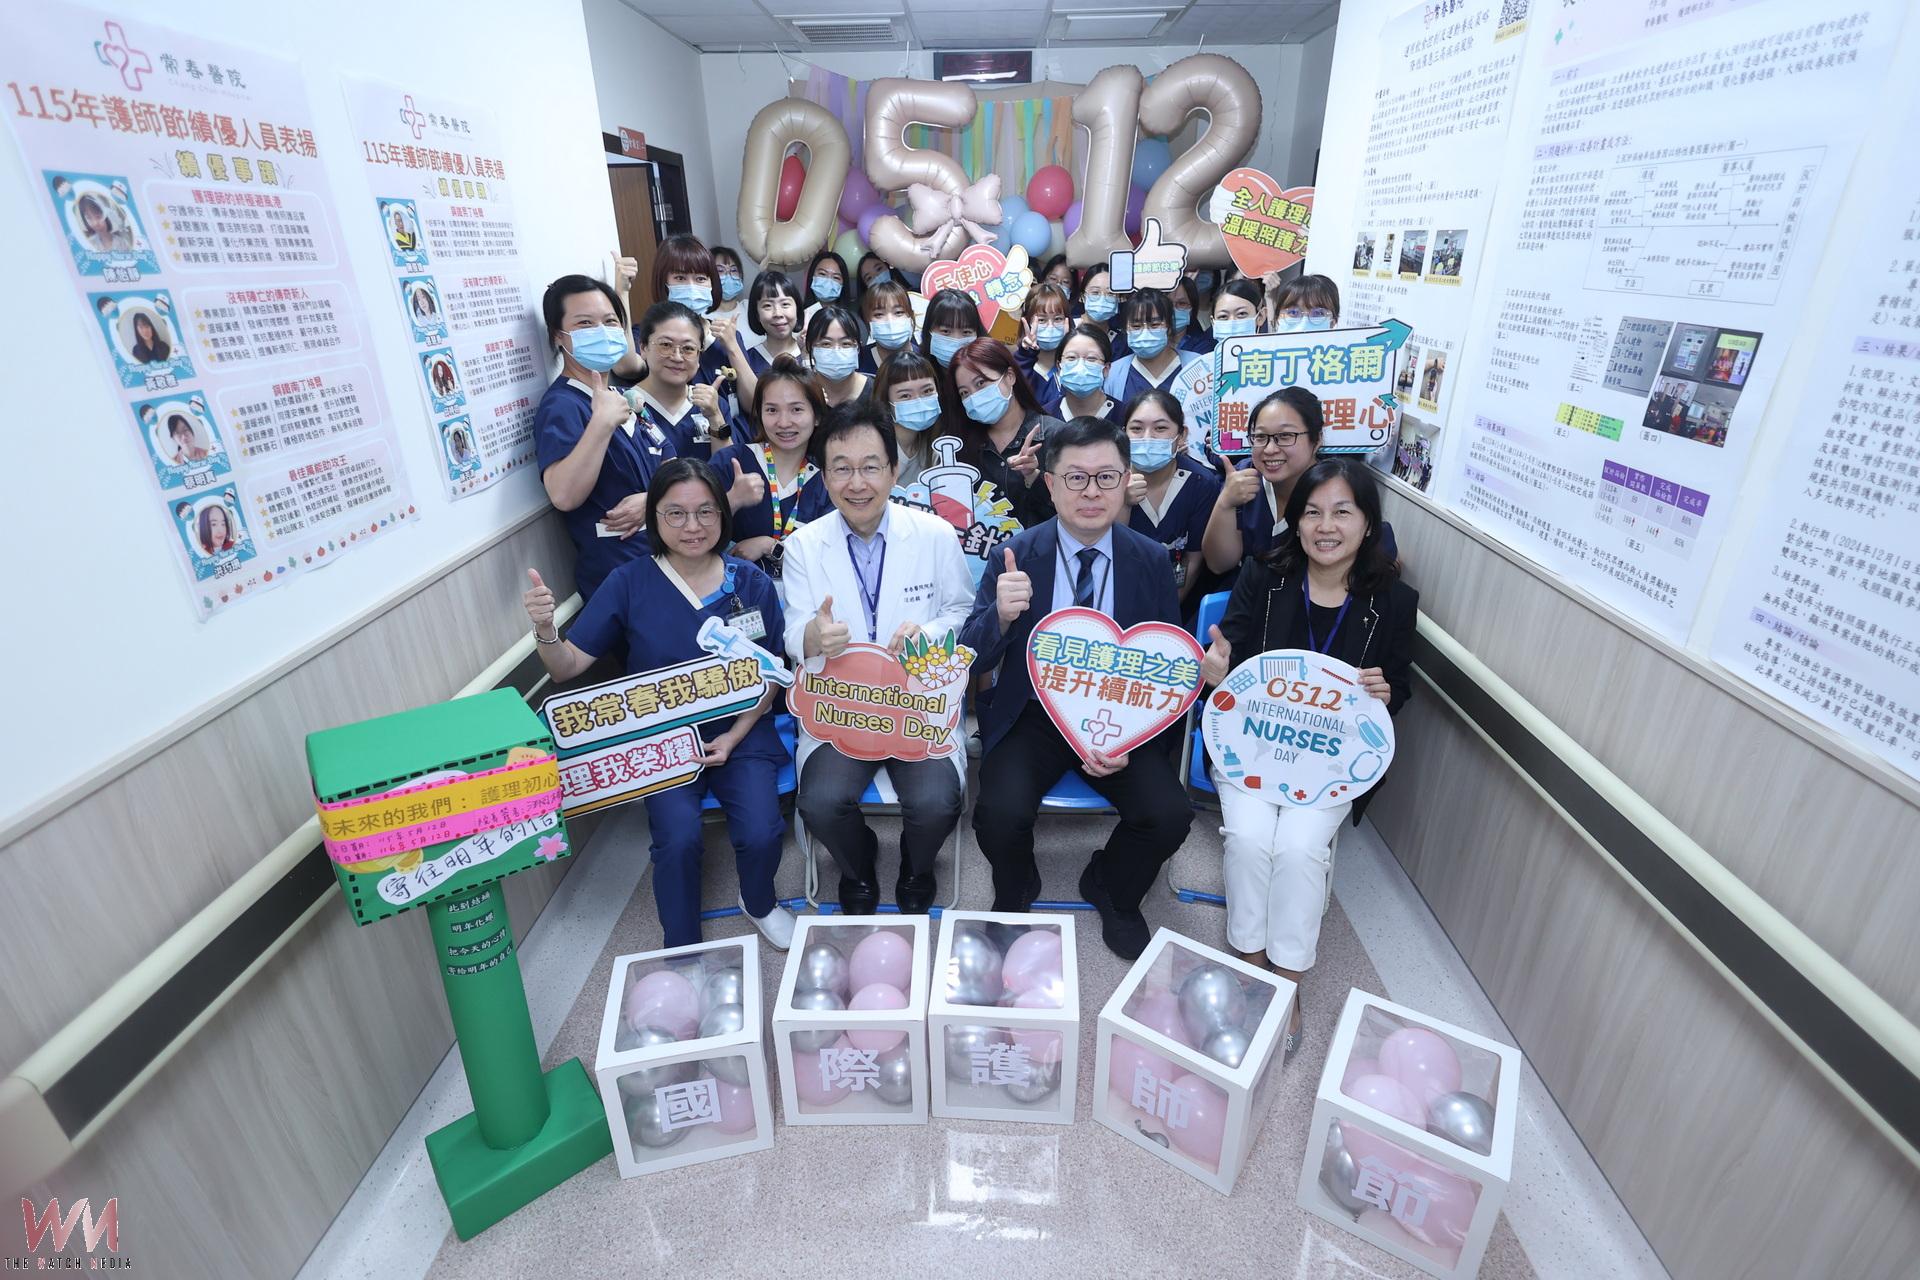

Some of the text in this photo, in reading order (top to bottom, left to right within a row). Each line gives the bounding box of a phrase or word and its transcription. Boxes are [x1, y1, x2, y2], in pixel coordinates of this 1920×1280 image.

[160, 53, 247, 89] 常春醫院
[8, 82, 318, 159] 115年護師節績優人員表揚
[1231, 186, 1311, 229] 全人護理
[935, 260, 992, 289] 天使心
[1238, 342, 1386, 387] 南丁格爾
[1031, 631, 1201, 690] 看見護理之美
[552, 657, 763, 738] 我常春我驕傲
[805, 674, 946, 714] International
[1038, 663, 1185, 714] 提升續航力
[1266, 677, 1342, 711] 0512
[815, 702, 951, 744] Nurses Day
[1243, 716, 1342, 756] NURSES
[1247, 699, 1346, 734] INTERNATIONAL
[1274, 748, 1299, 764] DAY
[654, 1042, 1446, 1227] 國 際 護 師 節
